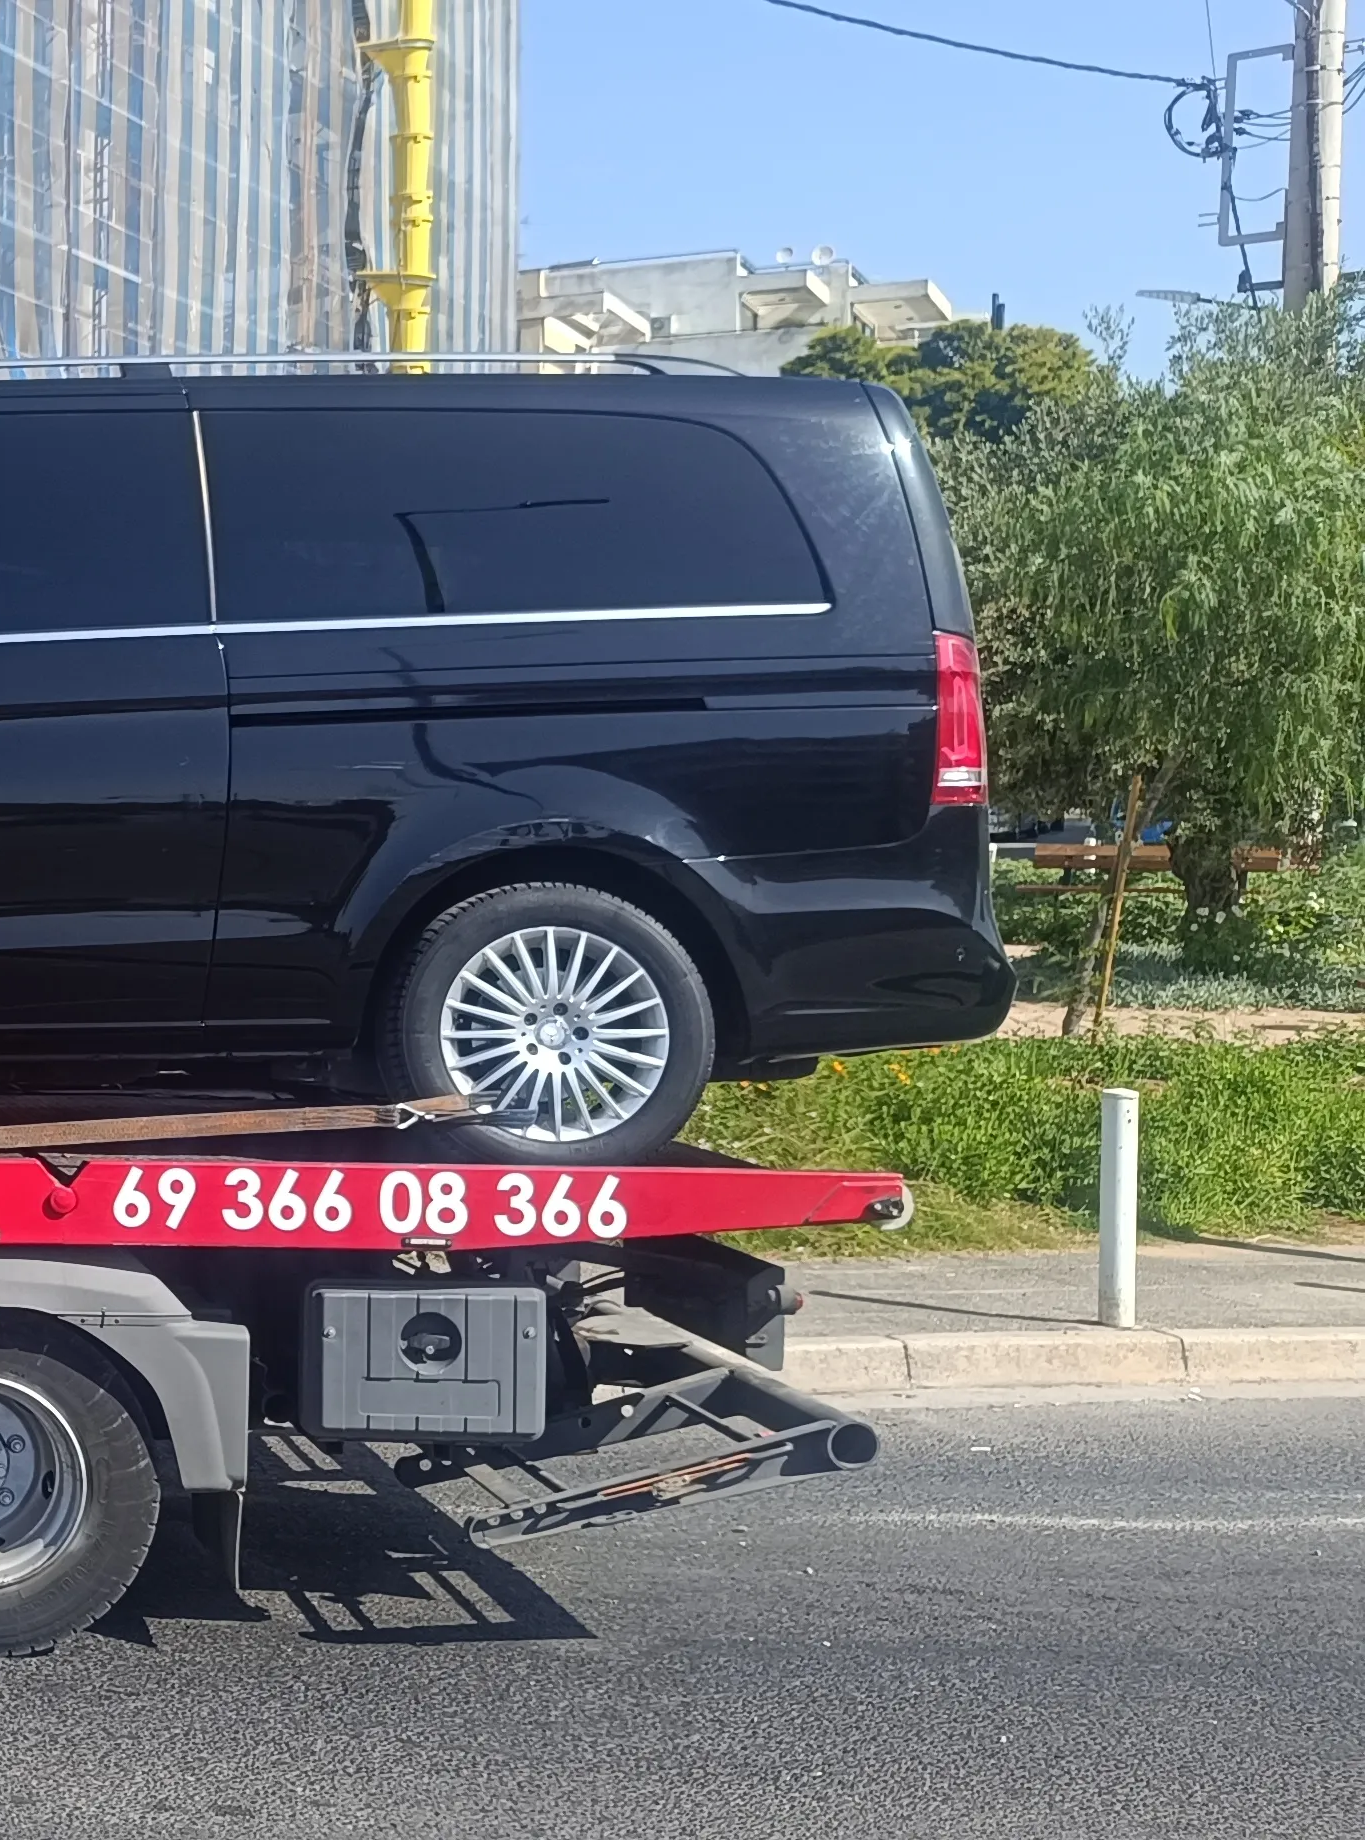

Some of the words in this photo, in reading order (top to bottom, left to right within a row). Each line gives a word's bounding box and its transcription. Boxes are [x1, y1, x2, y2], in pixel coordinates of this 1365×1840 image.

[112, 1165, 197, 1230] 69
[222, 1168, 353, 1233] 366
[379, 1170, 468, 1235] 08
[494, 1172, 628, 1239] 366
